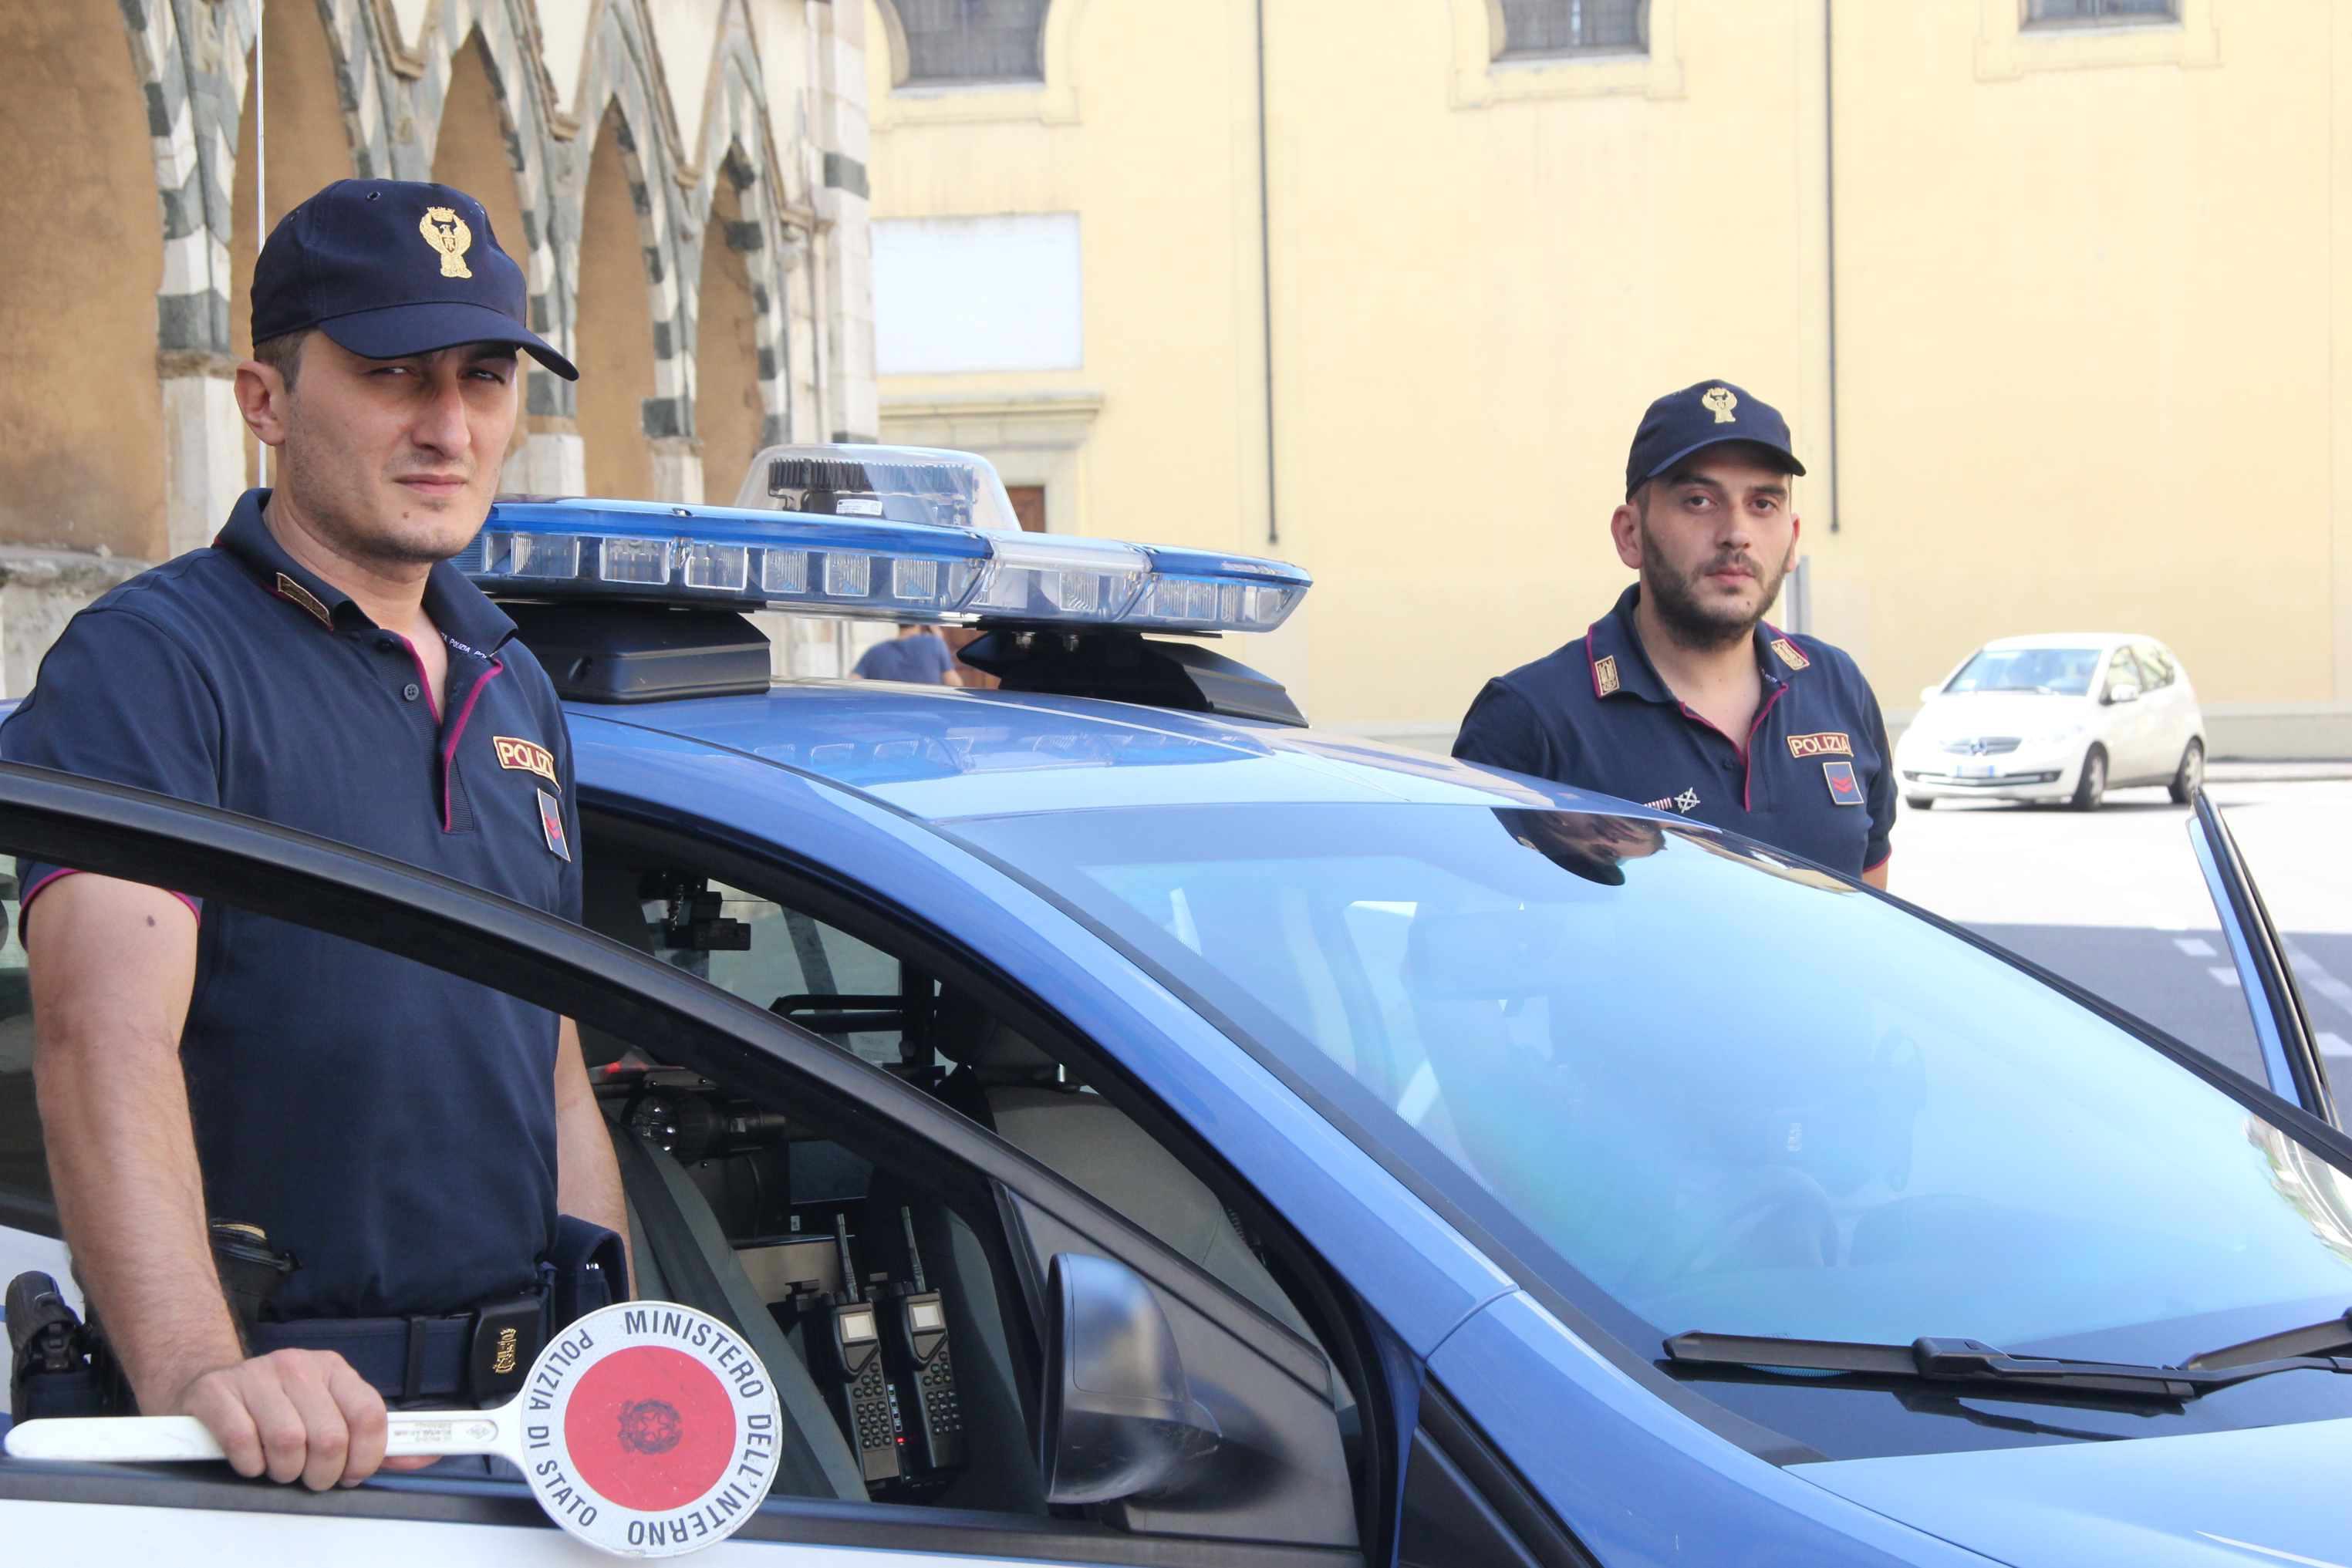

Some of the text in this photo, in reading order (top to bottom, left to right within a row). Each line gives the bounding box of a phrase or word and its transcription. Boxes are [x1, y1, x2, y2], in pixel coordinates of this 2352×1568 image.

[1790, 736, 1851, 755] POLIZIA
[528, 1329, 598, 1527] POLIZIA DI STATO
[624, 1310, 771, 1546] MINISTERO DELL'INTERNO
